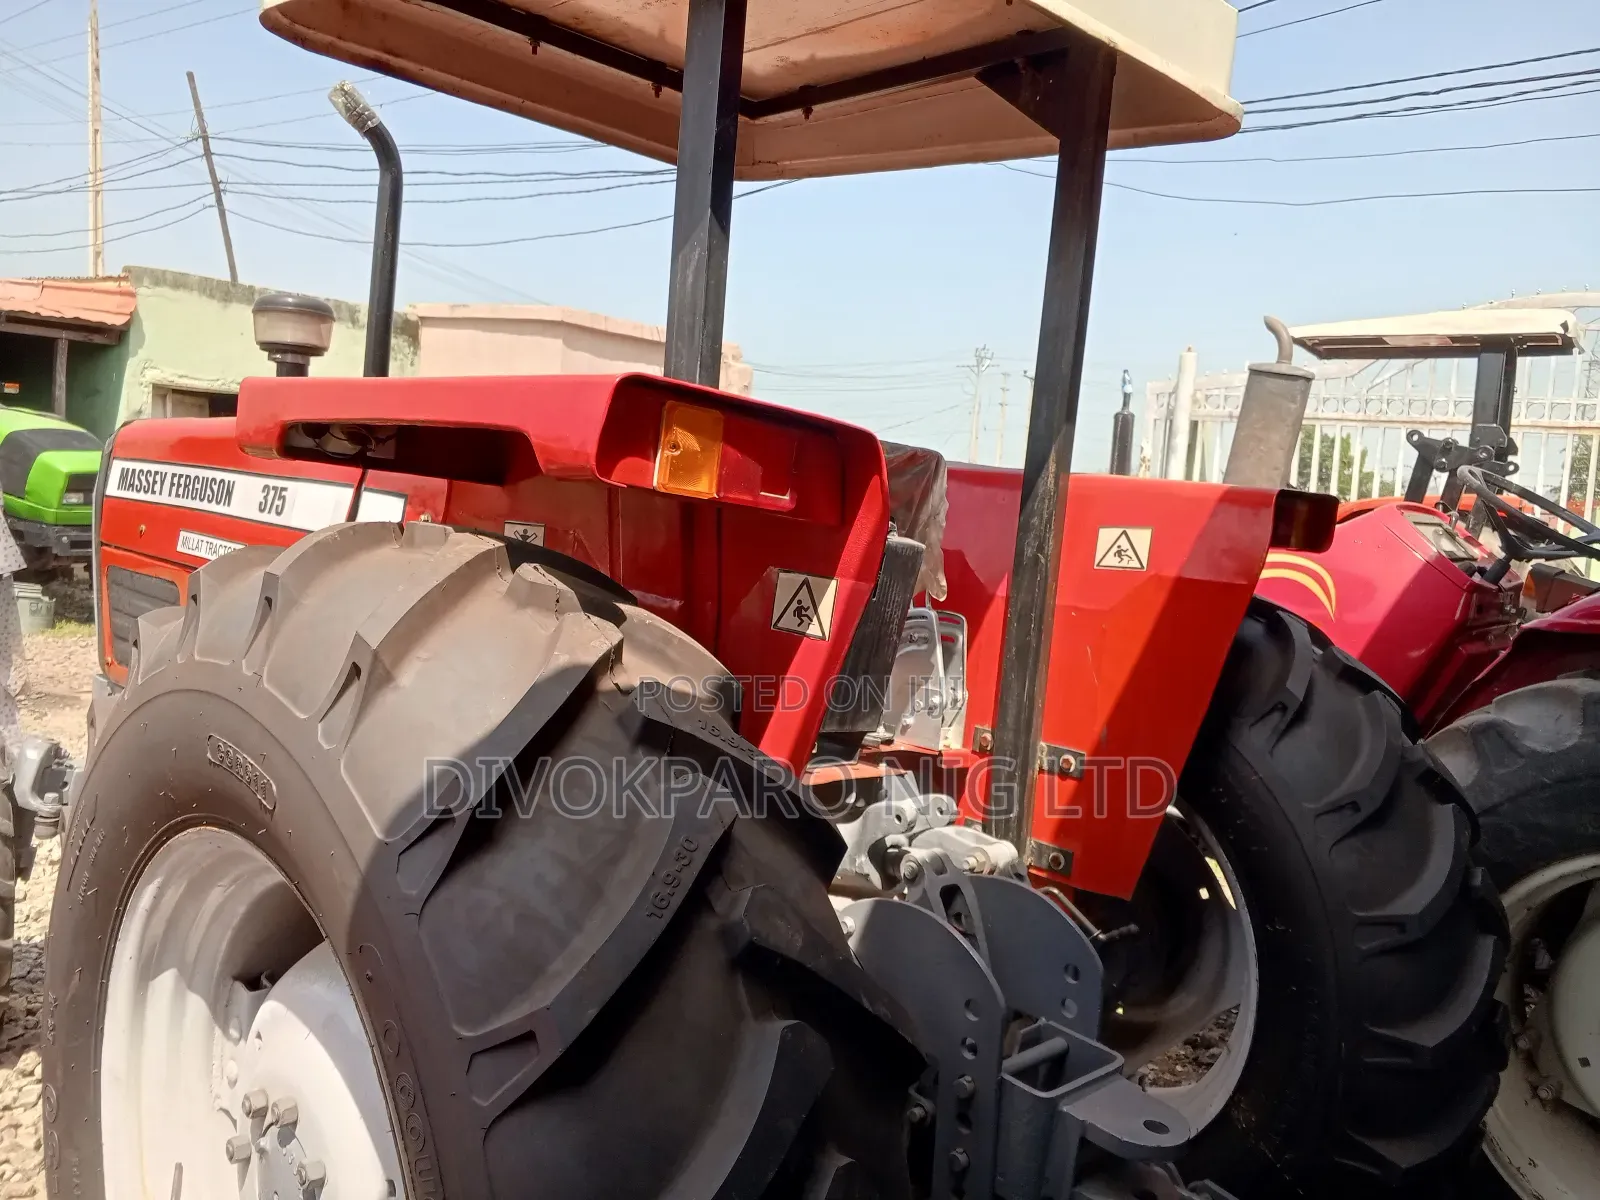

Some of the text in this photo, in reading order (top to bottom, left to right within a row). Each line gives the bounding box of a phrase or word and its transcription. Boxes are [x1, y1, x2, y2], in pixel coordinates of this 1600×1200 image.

[116, 466, 289, 517] MASSEY FERGUSON 375
[180, 535, 204, 553] MILLAT
[645, 834, 699, 919] 16.9-30
